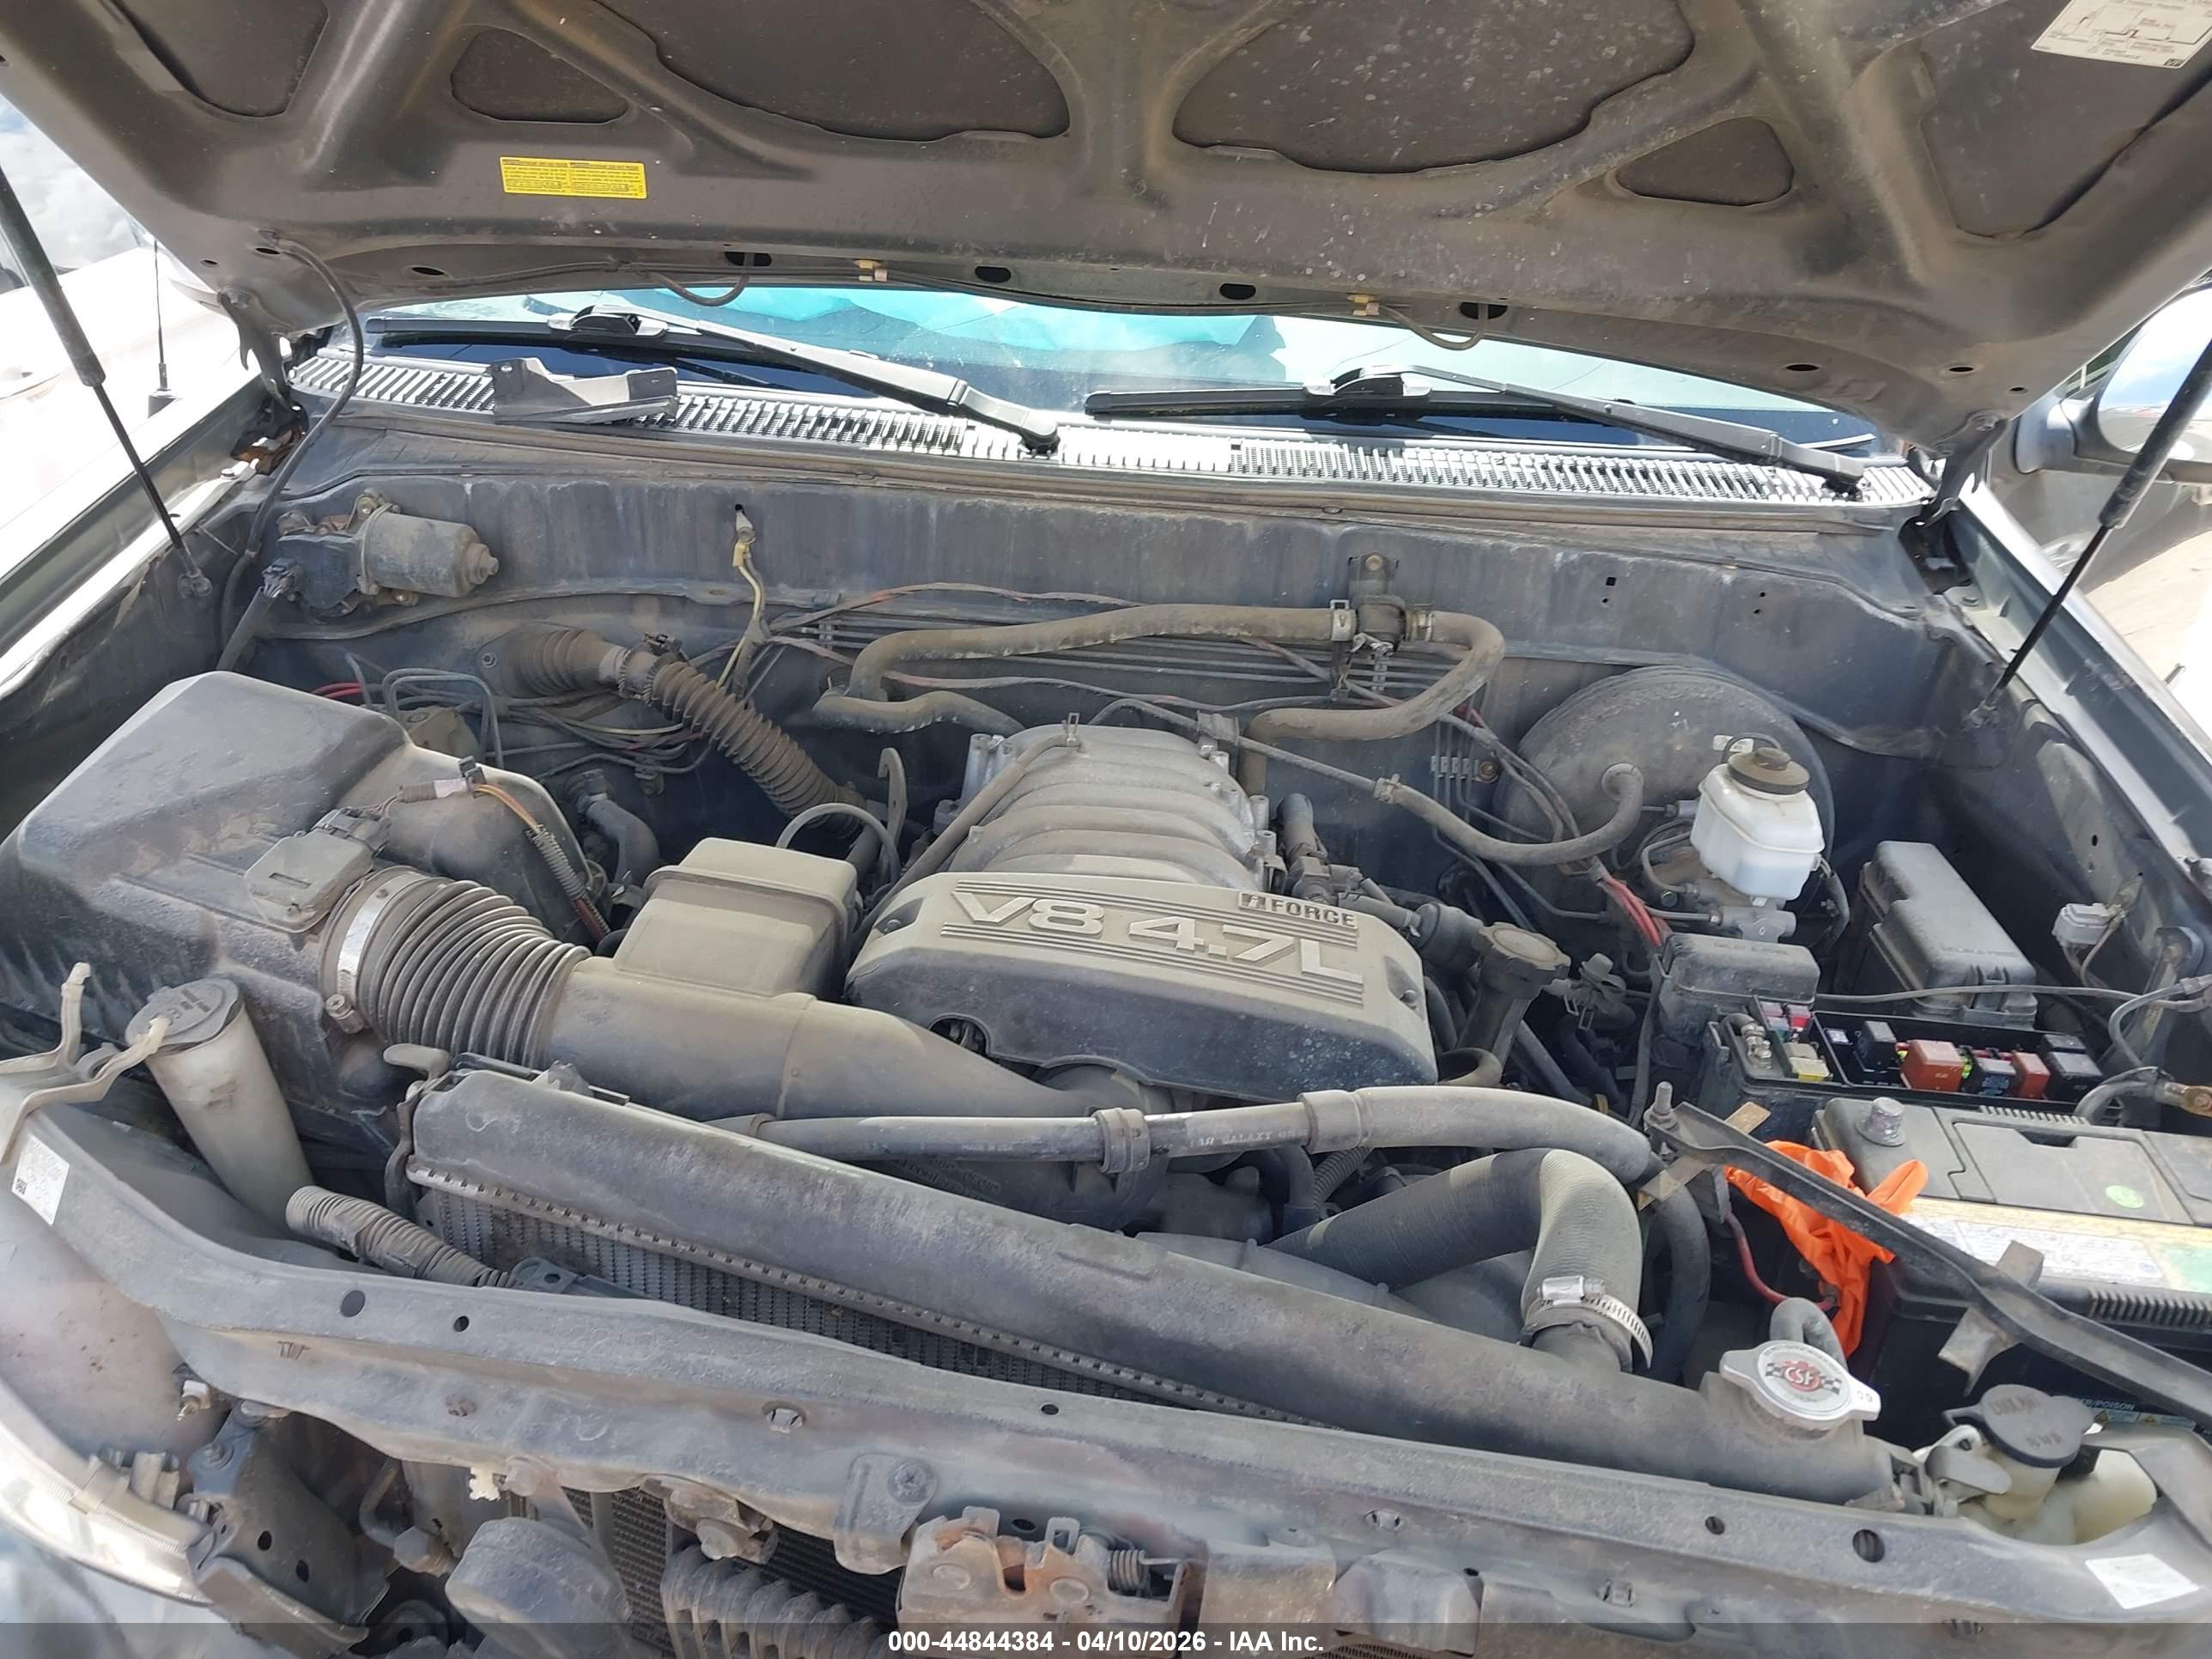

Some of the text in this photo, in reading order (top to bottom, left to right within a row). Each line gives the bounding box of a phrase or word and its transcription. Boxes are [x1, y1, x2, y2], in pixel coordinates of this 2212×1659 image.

[952, 890, 1364, 986] V8 4.7L
[1784, 1366, 1814, 1386] CSF
